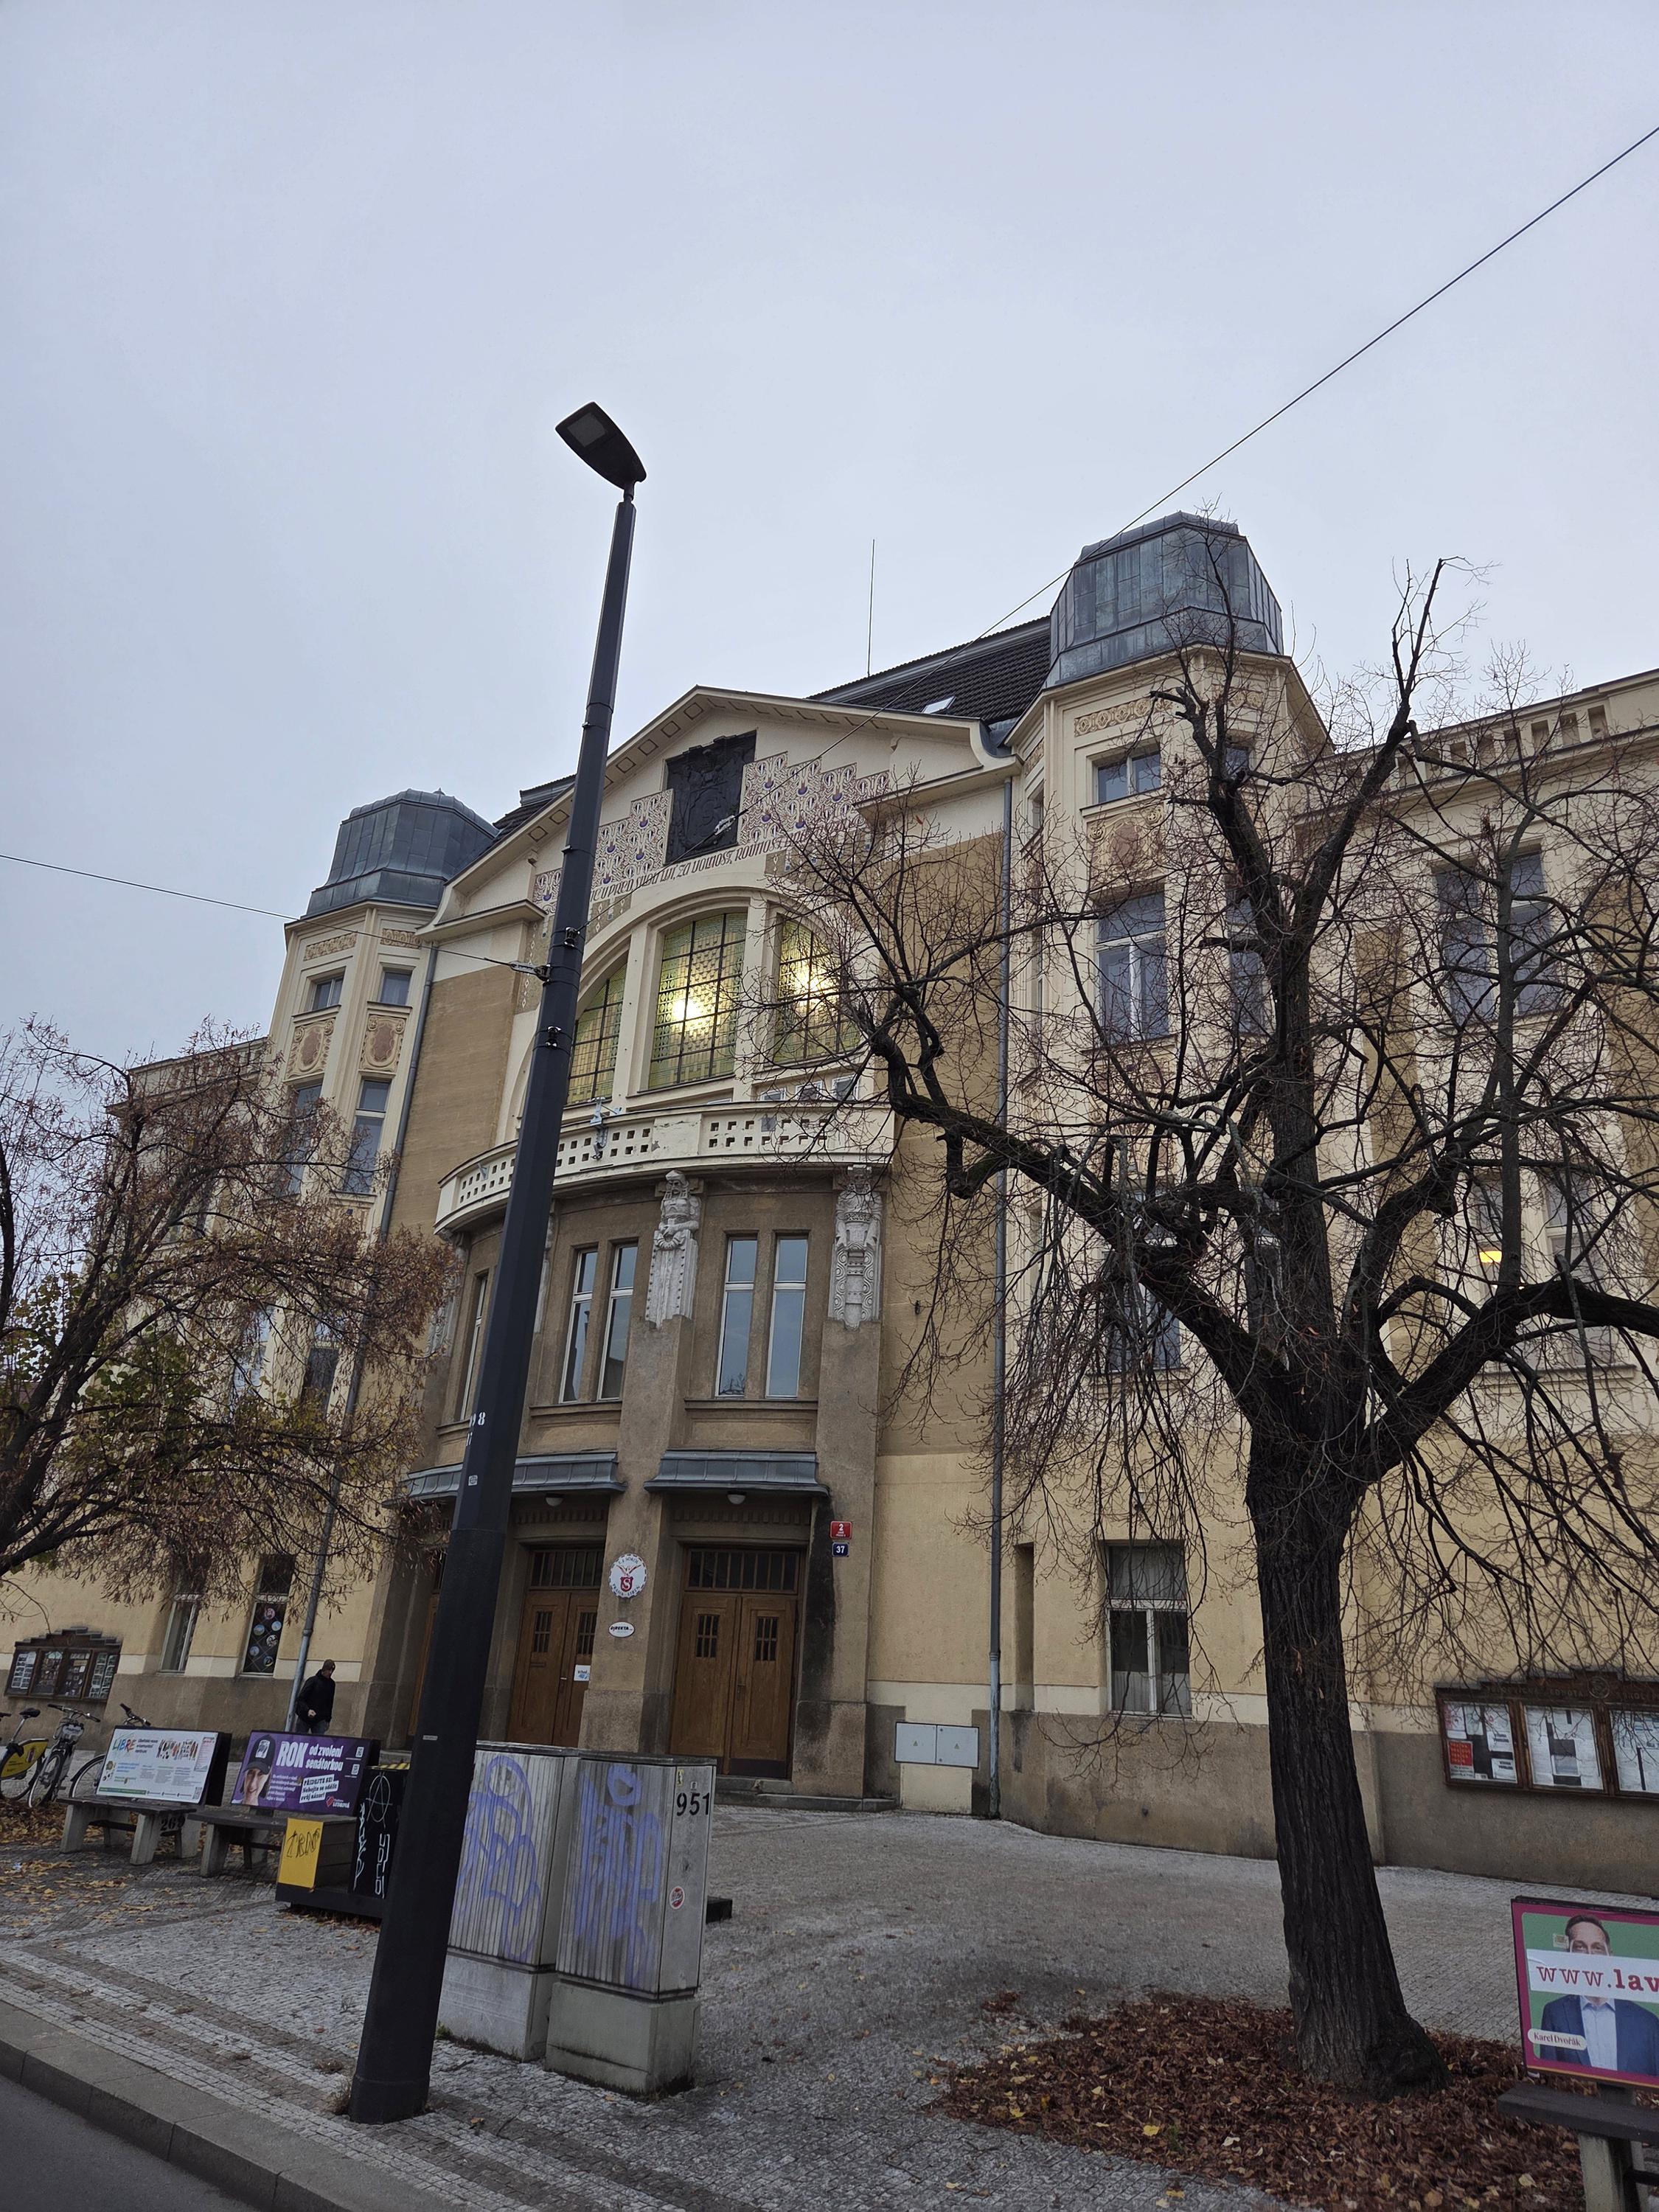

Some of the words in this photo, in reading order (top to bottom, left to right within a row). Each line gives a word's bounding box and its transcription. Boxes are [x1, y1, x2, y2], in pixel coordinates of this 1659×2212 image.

[838, 1523, 844, 1531] 2
[835, 1545, 845, 1554] 37
[112, 1739, 136, 1752] LIBRE
[276, 1741, 309, 1768] ROK
[309, 1744, 319, 1756] od
[318, 1745, 344, 1758] zvolení
[305, 1758, 344, 1772] senátorkou
[676, 1792, 709, 1816] 951
[1536, 1965, 1659, 1994] www.lav
[1534, 2031, 1554, 2042] Karel
[1554, 2034, 1582, 2047] Dvořák
